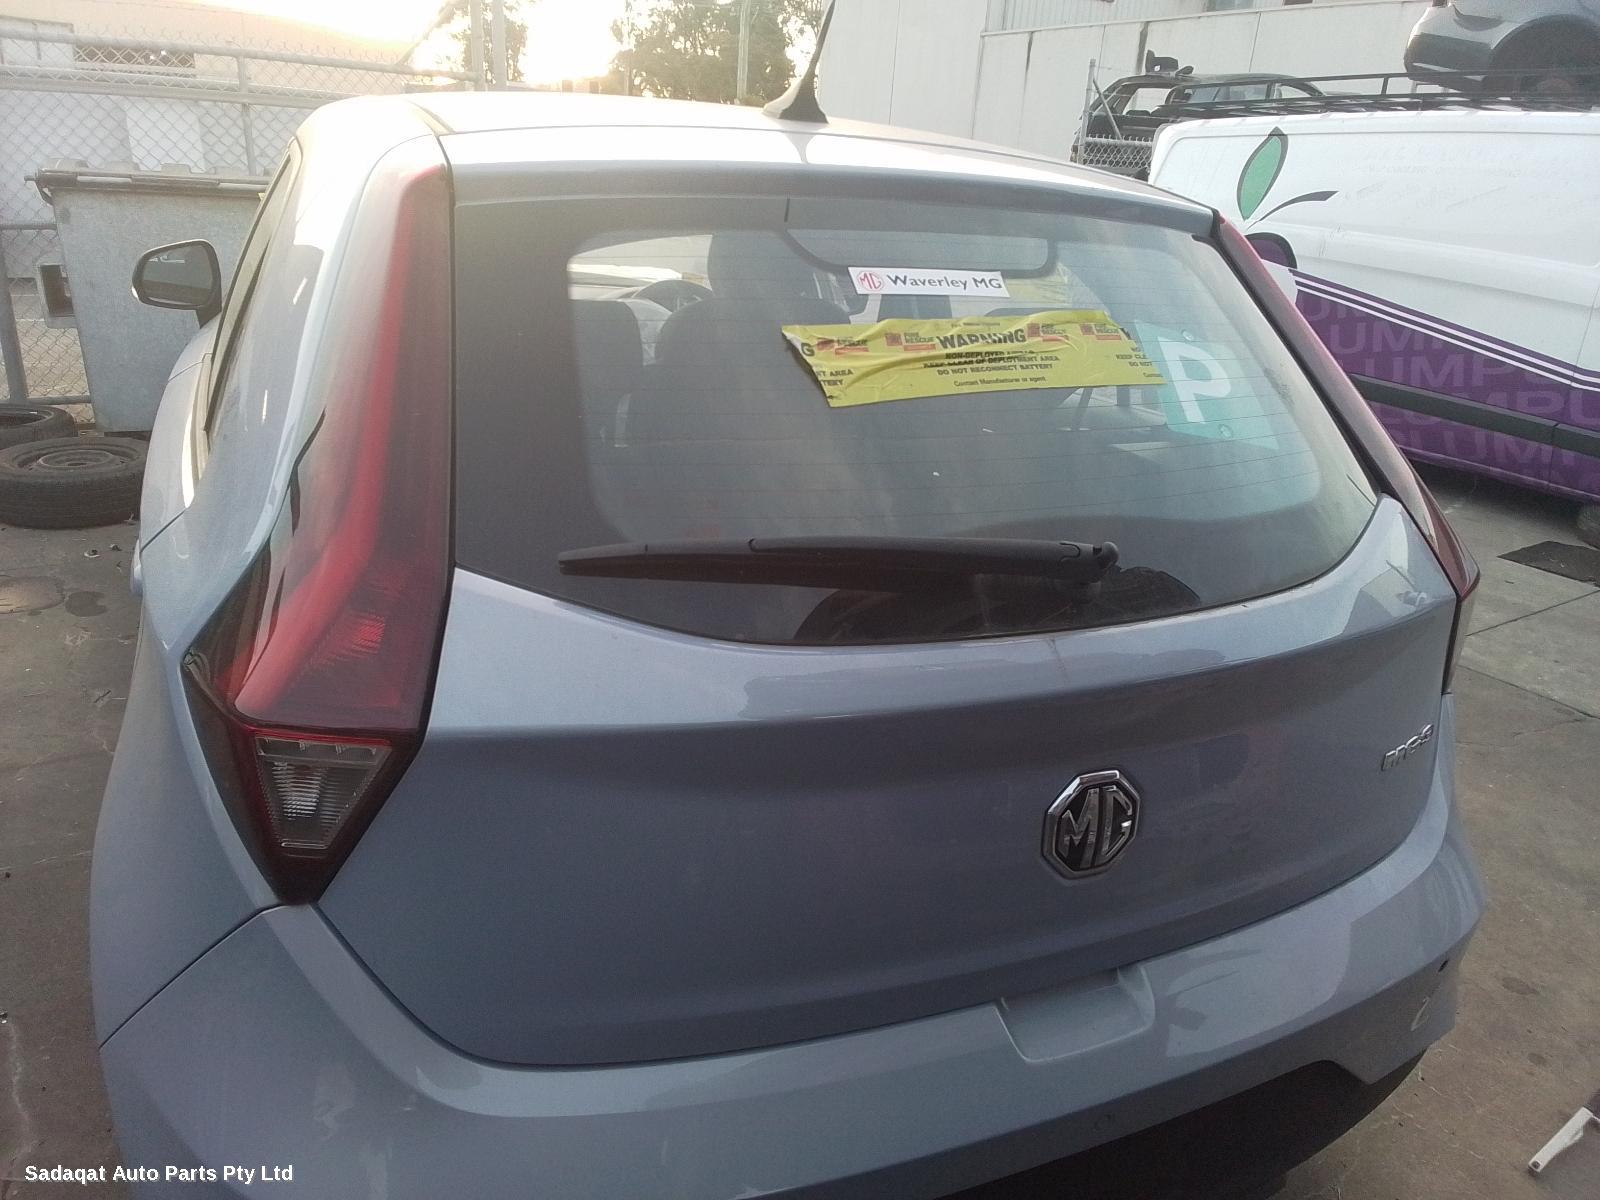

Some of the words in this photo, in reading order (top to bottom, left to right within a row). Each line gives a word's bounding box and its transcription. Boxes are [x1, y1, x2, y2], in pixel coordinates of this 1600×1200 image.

[859, 272, 882, 290] MG
[887, 275, 968, 291] Waverley
[972, 277, 1003, 289] MG
[937, 368, 949, 376] DO
[1158, 336, 1231, 424] P
[1058, 783, 1134, 870] MG
